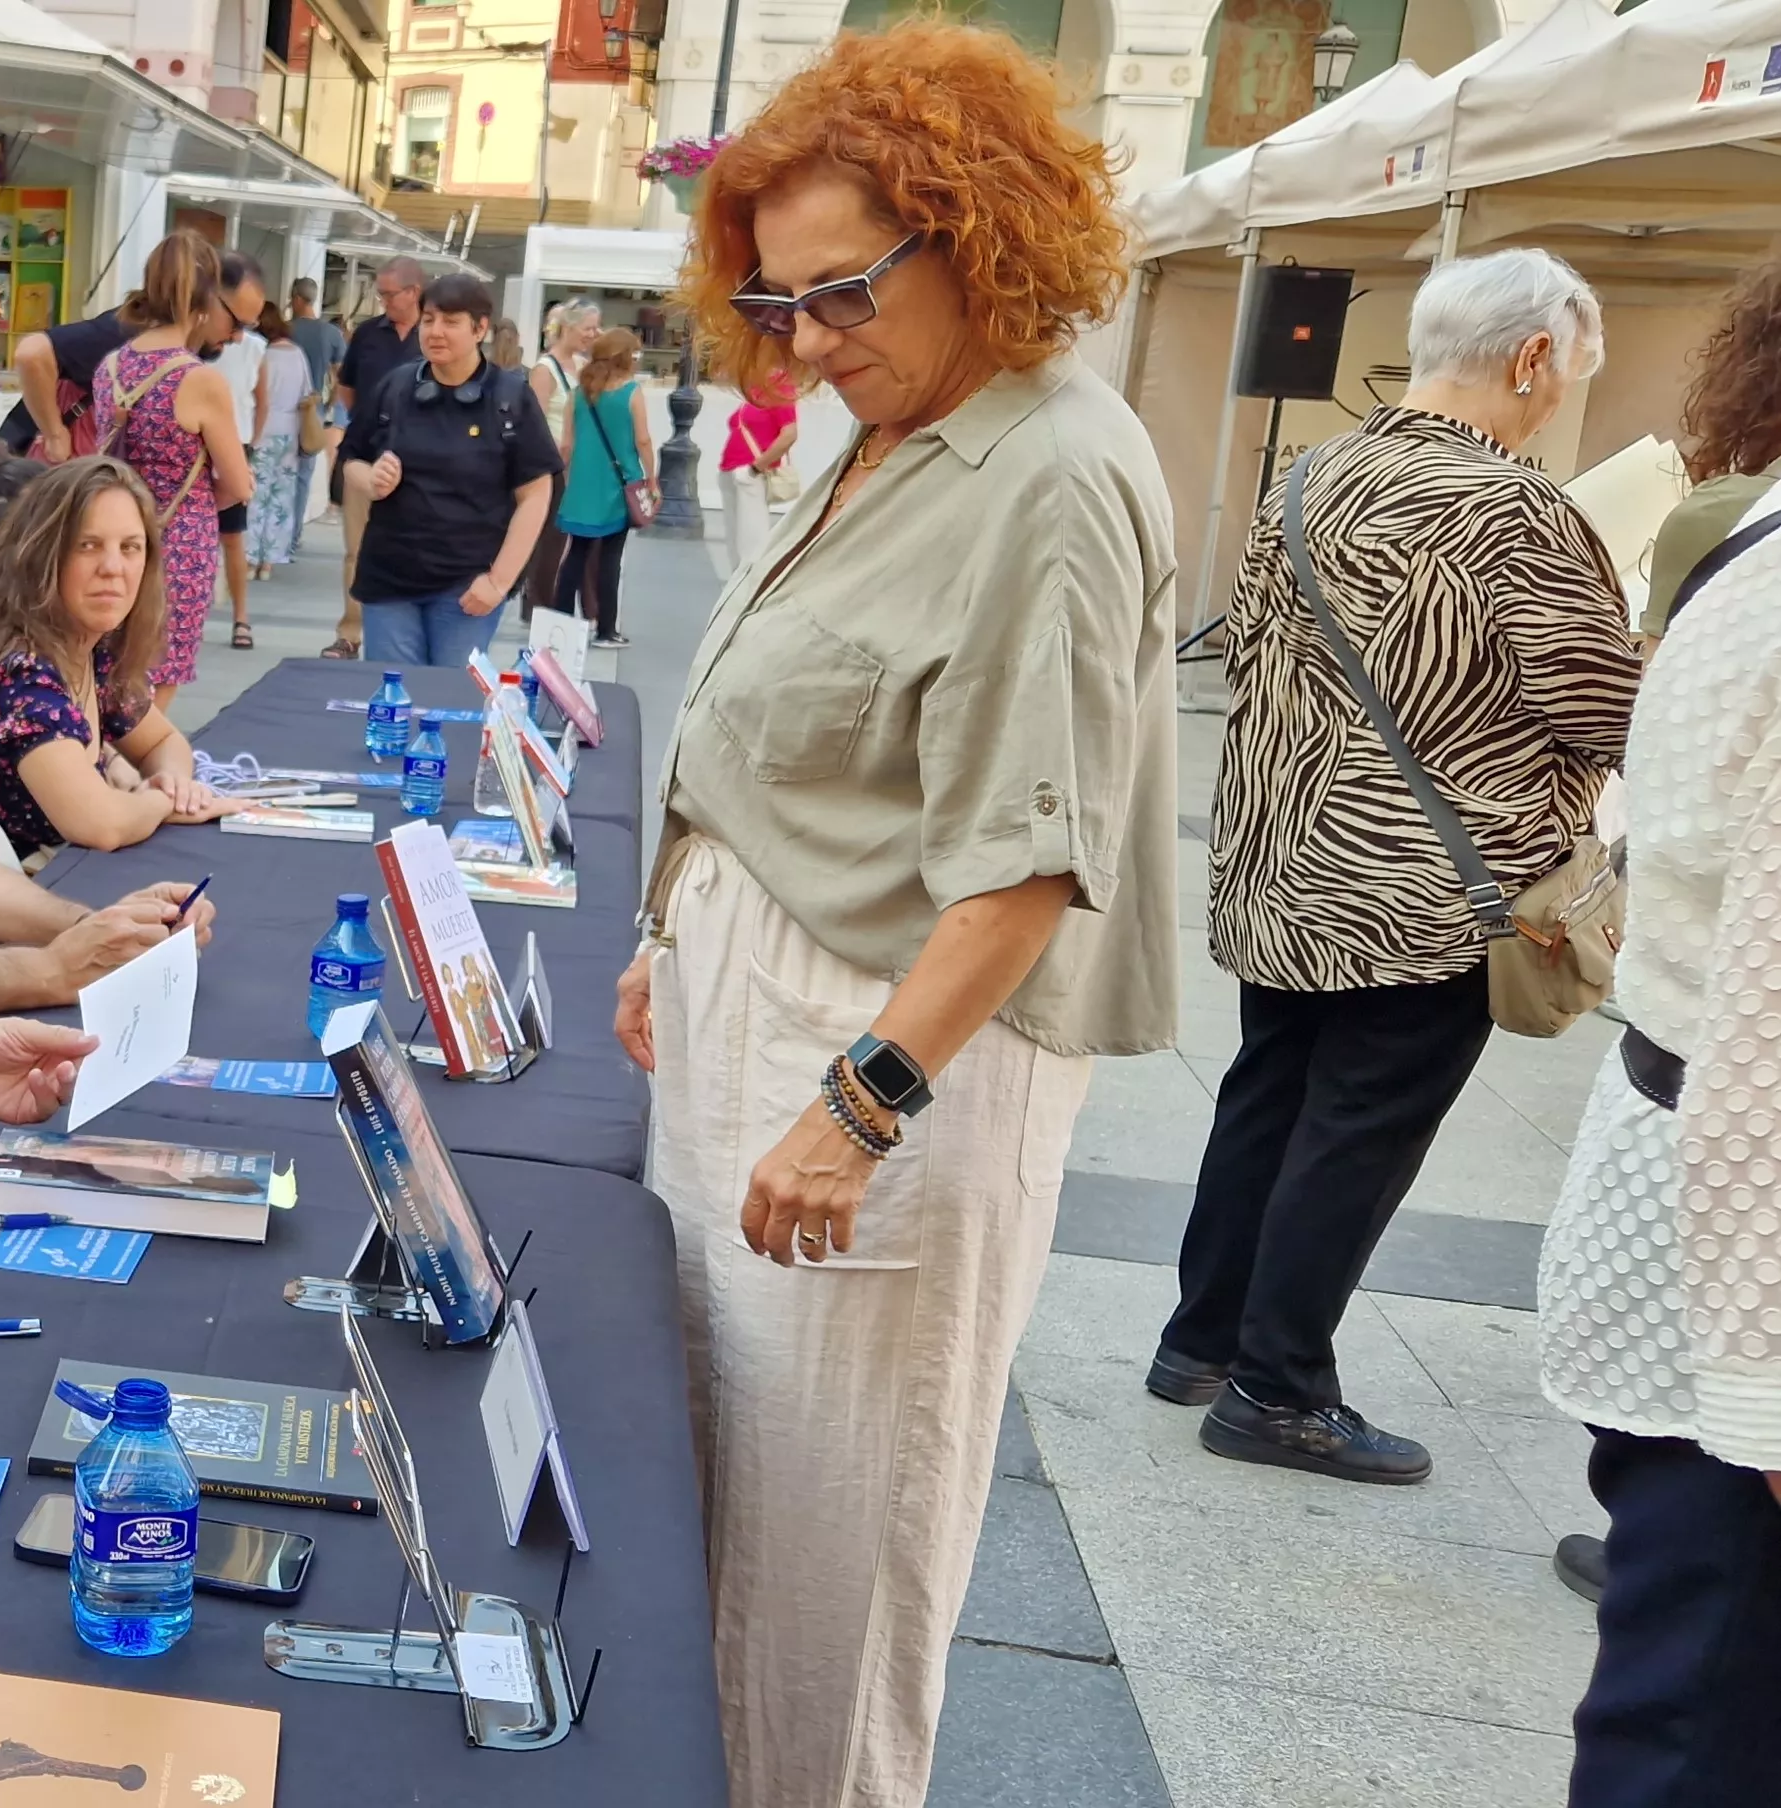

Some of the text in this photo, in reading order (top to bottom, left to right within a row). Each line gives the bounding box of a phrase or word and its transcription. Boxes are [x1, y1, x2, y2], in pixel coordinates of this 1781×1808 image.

[420, 870, 461, 906] AMOR
[431, 910, 474, 943] MUERTE
[350, 1070, 458, 1307] NADIE PUEDE CAMBIAR EL PASADO LUIS EXPÓSITO
[298, 1409, 313, 1446] MISTERIOS
[274, 1395, 297, 1477] LA CAMPANA DE HUESCA
[223, 1485, 257, 1498] HUESCA
[258, 1490, 270, 1500] DE
[271, 1492, 314, 1504] CAMPANA
[315, 1496, 327, 1506] LA
[136, 1522, 172, 1531] MONTE
[140, 1530, 172, 1538] PINOS
